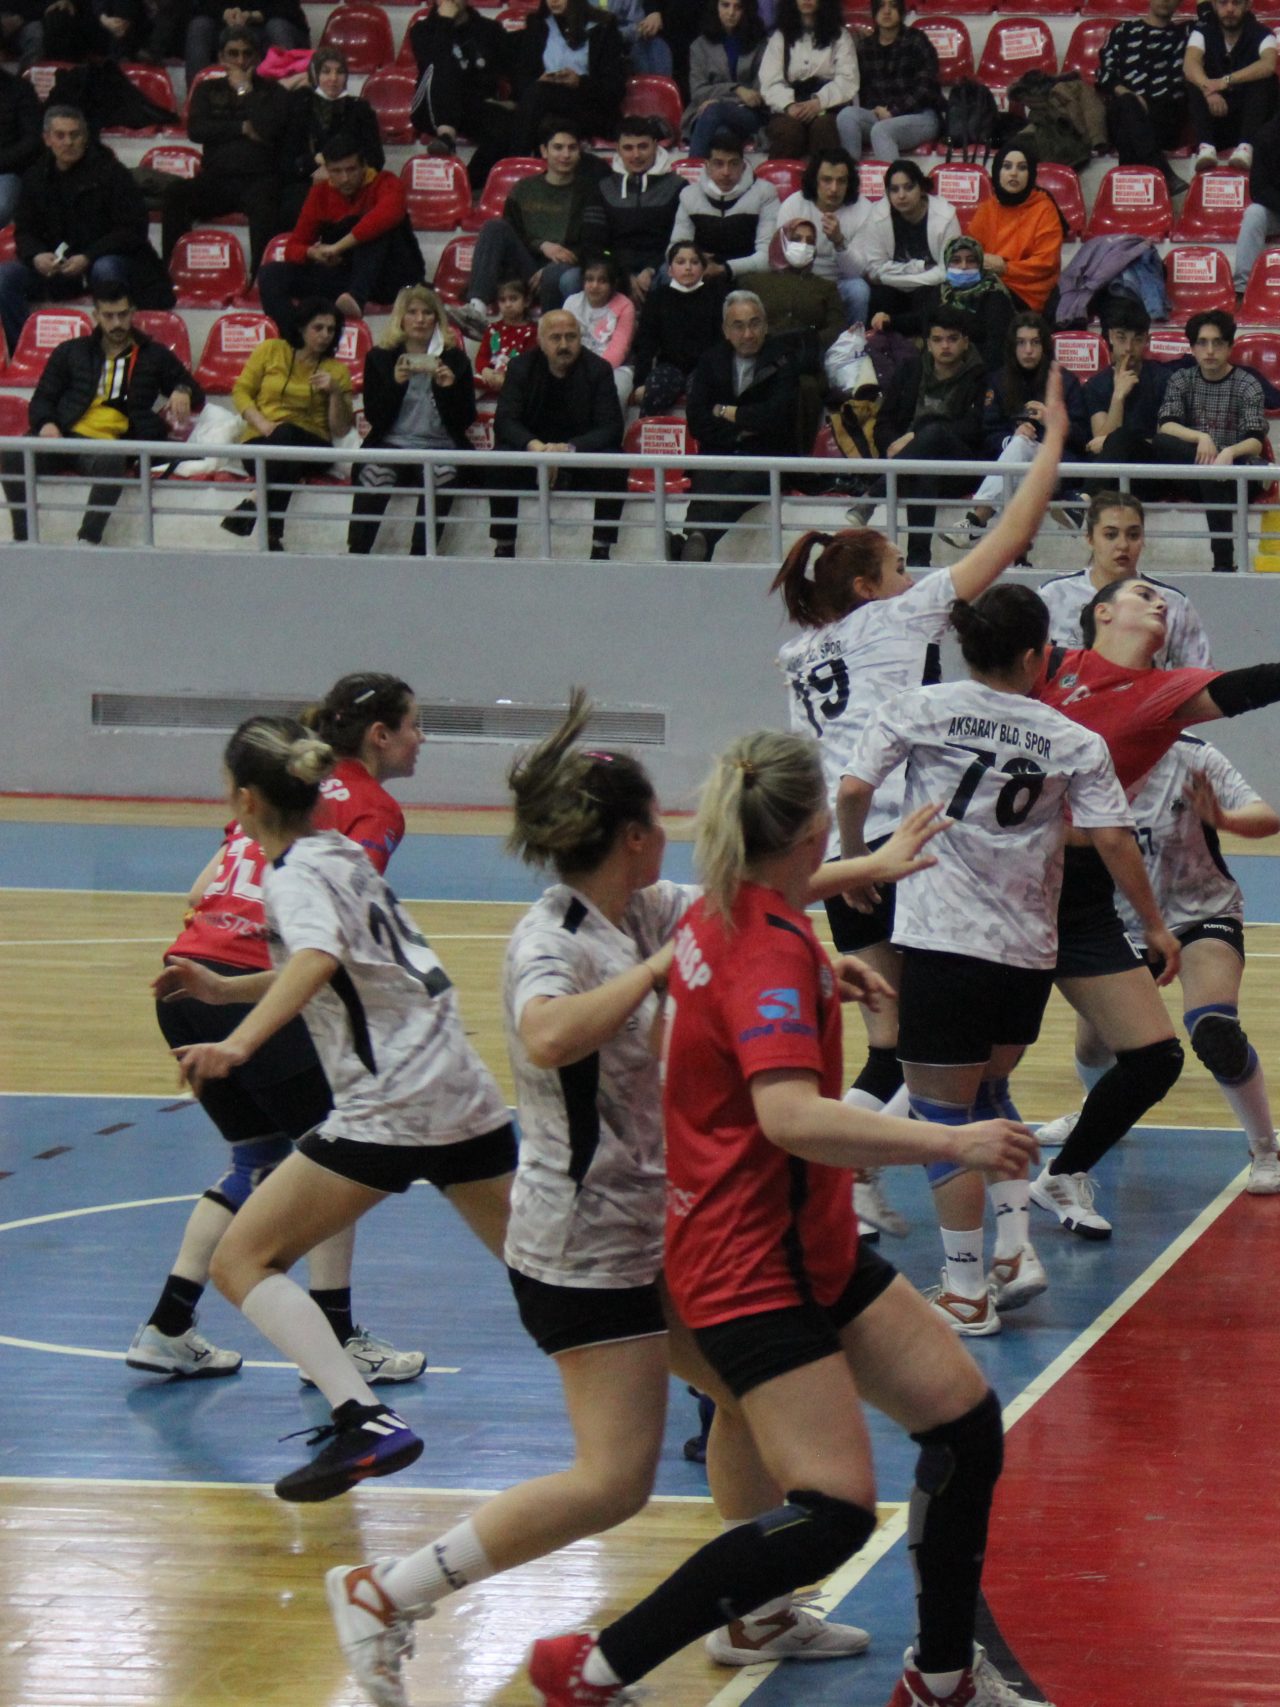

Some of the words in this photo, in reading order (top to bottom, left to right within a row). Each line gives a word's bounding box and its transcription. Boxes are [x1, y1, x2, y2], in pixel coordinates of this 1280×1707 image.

[948, 716, 999, 740] AKSARAY
[1000, 724, 1022, 748] BLD.
[1025, 731, 1051, 760] SPOR
